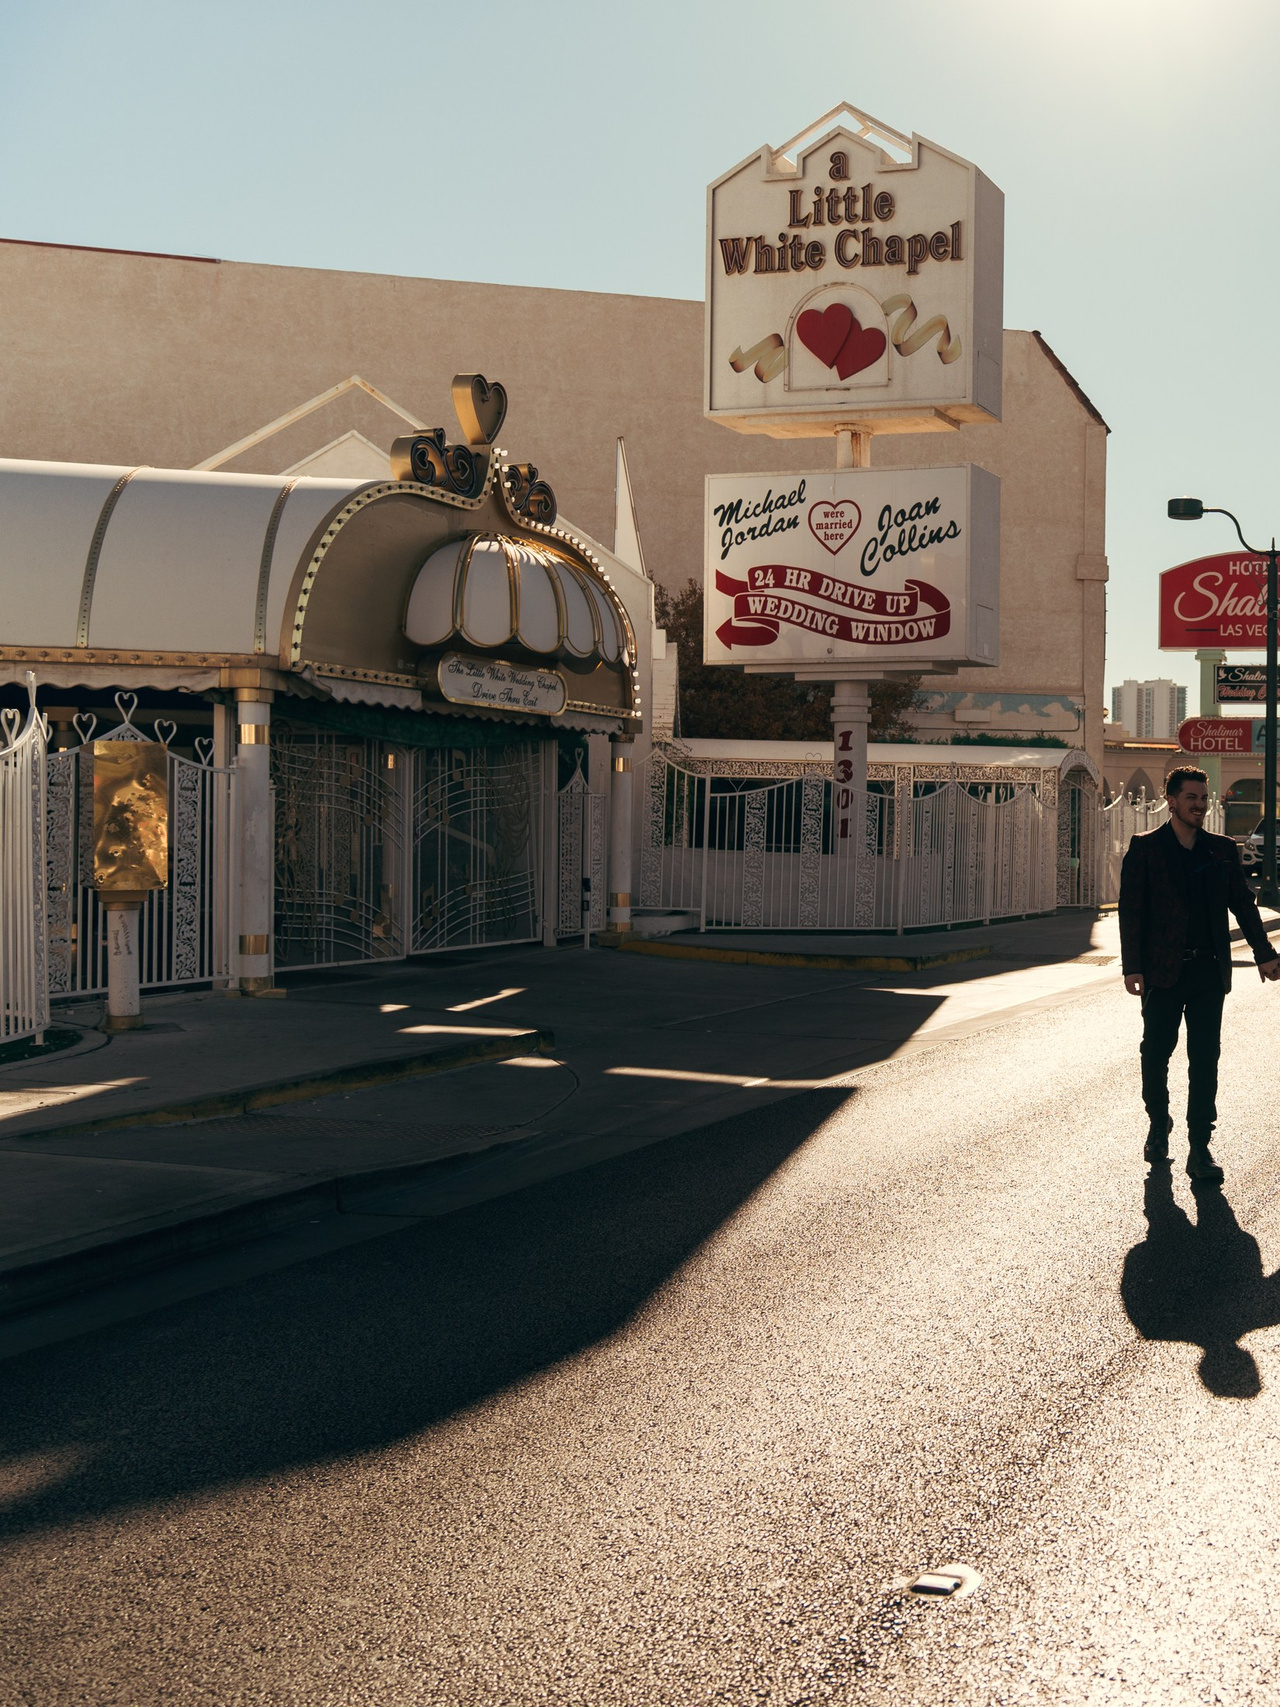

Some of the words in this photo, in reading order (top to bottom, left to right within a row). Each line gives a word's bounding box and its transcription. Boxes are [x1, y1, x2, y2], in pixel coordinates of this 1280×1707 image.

[828, 151, 850, 180] a
[787, 182, 895, 229] Little
[718, 232, 825, 275] White
[834, 220, 963, 275] Chapel
[713, 479, 806, 527] Michael
[823, 510, 845, 519] were
[720, 515, 800, 560] Jordan
[815, 519, 853, 530] married
[823, 531, 845, 541] here
[877, 497, 941, 546] Joan
[860, 520, 961, 577] Collins
[754, 569, 775, 587] 24
[784, 568, 812, 590] HR
[818, 578, 876, 610] DRIVE
[886, 595, 911, 613] UP
[747, 596, 839, 635] WEDDING
[850, 618, 937, 642] WINDOW
[1220, 624, 1243, 636] LAS
[448, 660, 464, 675] The
[465, 662, 485, 678] Little
[487, 666, 507, 682] White
[508, 669, 535, 692] Wedding
[536, 675, 559, 693] Chapel
[472, 682, 497, 700] Drive
[499, 687, 521, 704] Thru
[1190, 721, 1244, 738] Shalimar
[1190, 737, 1243, 750] HOTEL
